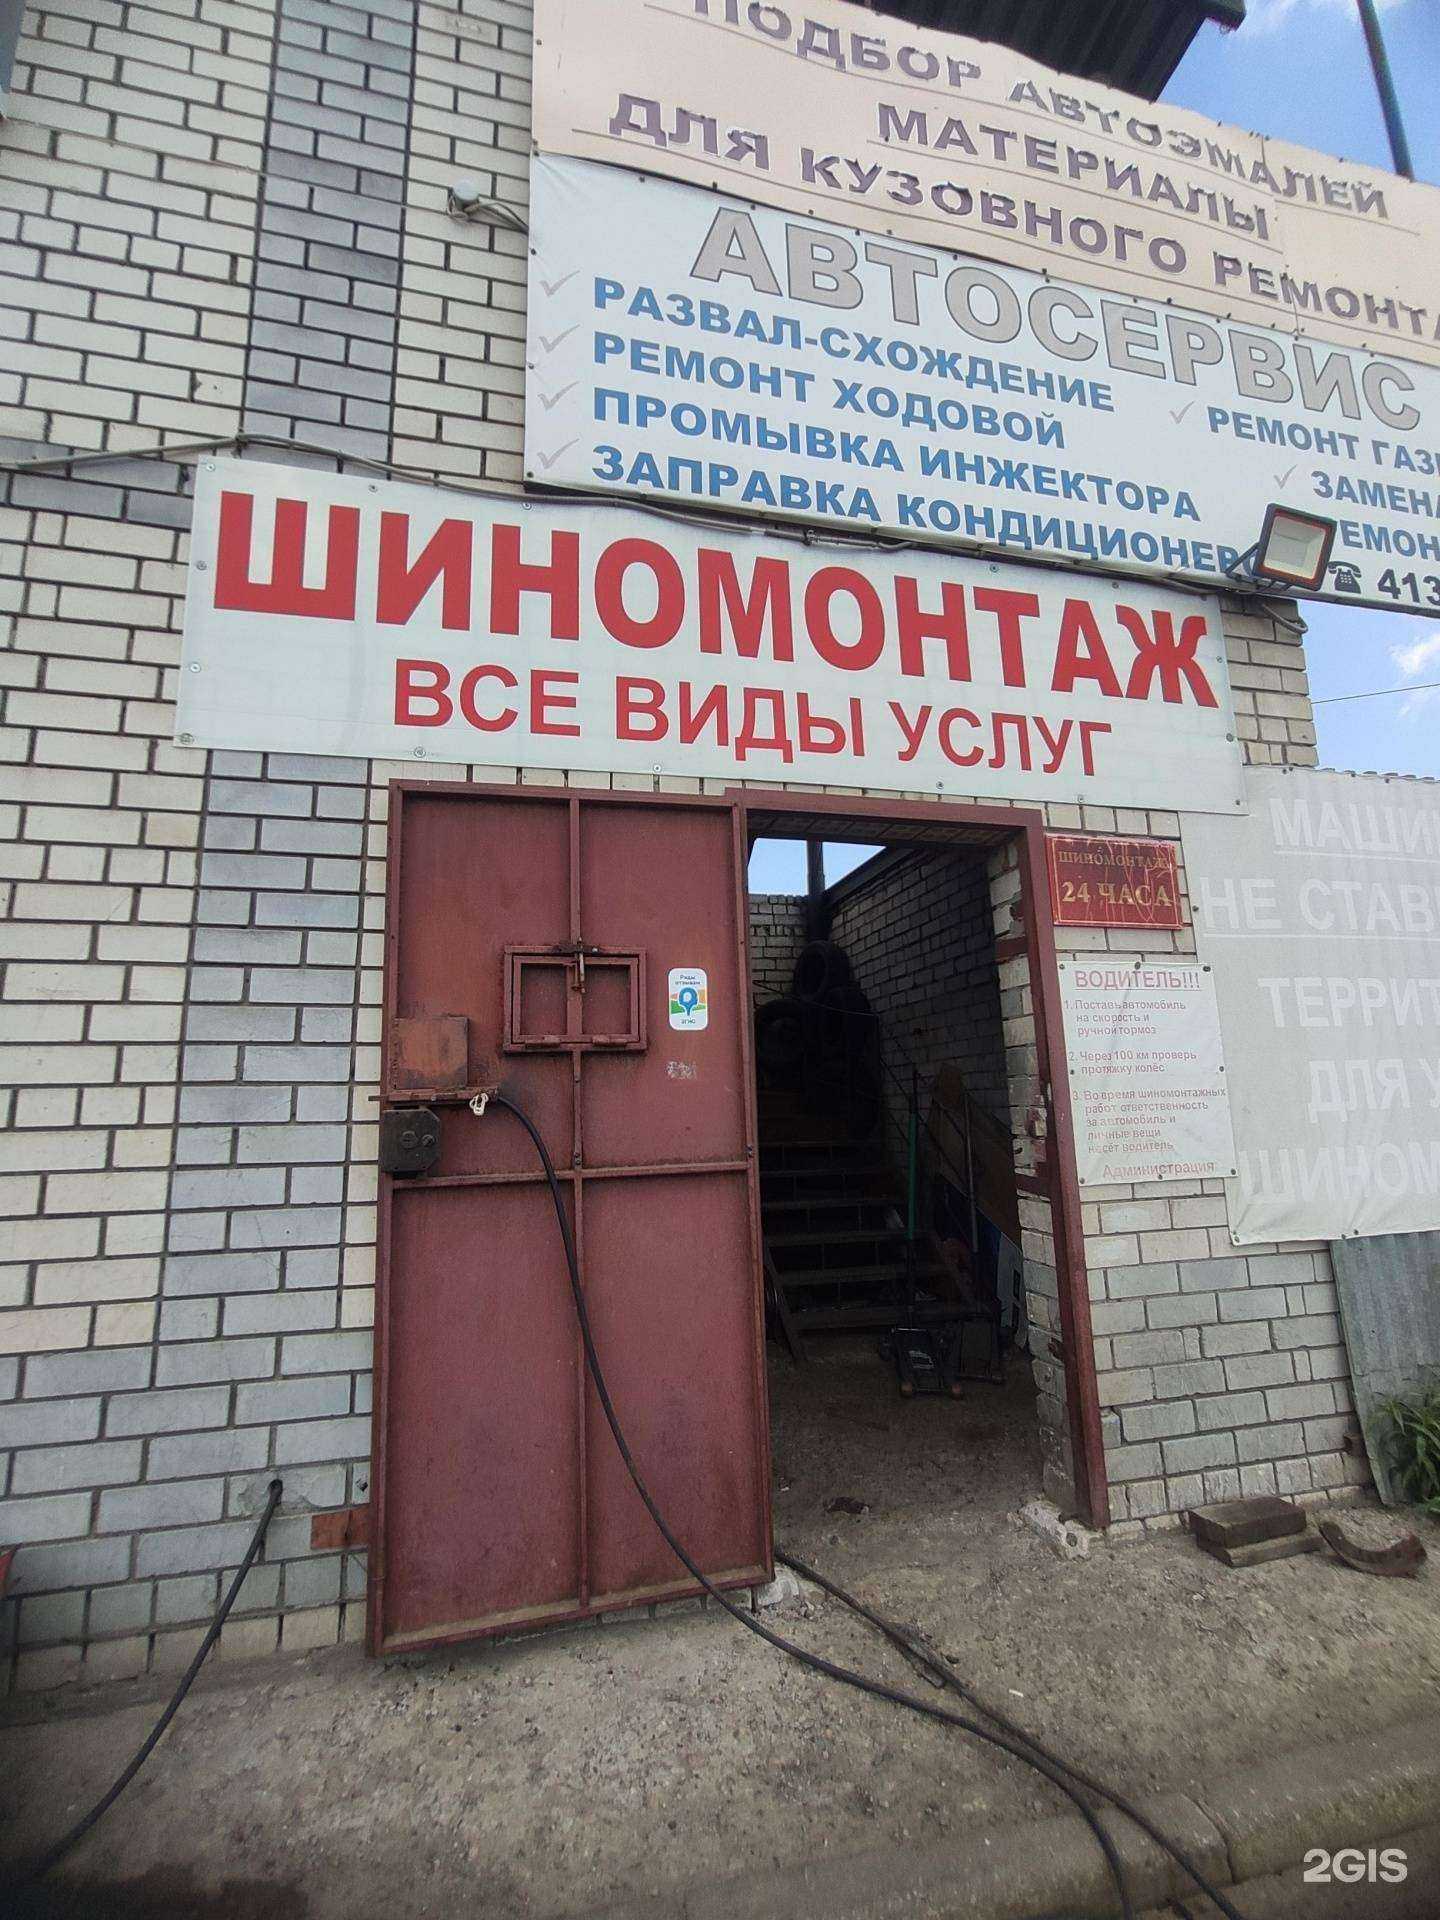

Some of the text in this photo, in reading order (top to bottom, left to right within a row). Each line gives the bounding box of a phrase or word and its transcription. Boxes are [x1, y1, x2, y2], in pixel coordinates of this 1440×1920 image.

[877, 101, 1270, 241] МАТЕРИАЛЫ
[1008, 78, 1389, 219] АВТОЭМАЛЕЙ
[608, 92, 1440, 340] ДЛЯ КУЗОВНОГО РЕМОНТ
[689, 206, 1421, 431] АВТОСЕРВИС
[593, 276, 1115, 412] РАЗВАЛ-СХОЖДЕНИЕ
[593, 331, 1066, 449] РЕМОНТ ХОДОВОЙ
[593, 386, 1201, 522] ПРОМЫВКА ИНЖЕКТОРА
[1207, 406, 1360, 461] РЕМОНТ
[591, 444, 882, 522] ЗАПРАВКА
[1311, 470, 1440, 519] ЗАМЕН
[1339, 519, 1440, 562] ЕМОН
[213, 490, 1220, 708] ШИНОМОНТАЖ
[1376, 567, 1440, 607] 413
[393, 658, 1113, 776] ВСЕ ВИДЫ УСЛУГ
[1268, 797, 1440, 853] МАШИ
[1061, 881, 1172, 907] 24 ЧАСА
[1200, 876, 1440, 933] НЕ СТАВ
[1074, 969, 1200, 989] ВОДИТЕЛЬ!!!
[1075, 1000, 1121, 1010] Поставь
[1122, 1000, 1186, 1010] автомобиль
[1076, 1014, 1089, 1022] на
[1092, 1014, 1140, 1024] скорость
[1077, 1025, 1157, 1036] ручной тормоз
[1080, 1051, 1112, 1063] Через
[1115, 1051, 1133, 1060] 100
[1136, 1051, 1149, 1060] км
[1151, 1052, 1197, 1062] проверь
[1081, 1064, 1131, 1076] протяжку
[1084, 1090, 1099, 1100] Во
[1101, 1090, 1135, 1102] время
[1138, 1088, 1226, 1099] шиномонтажных
[1085, 1102, 1208, 1116] работ ответственность
[1307, 1058, 1411, 1124] ДЛЯ
[1087, 1118, 1097, 1127] за
[1132, 1129, 1161, 1140] вещи
[1102, 1161, 1215, 1179] Администрация
